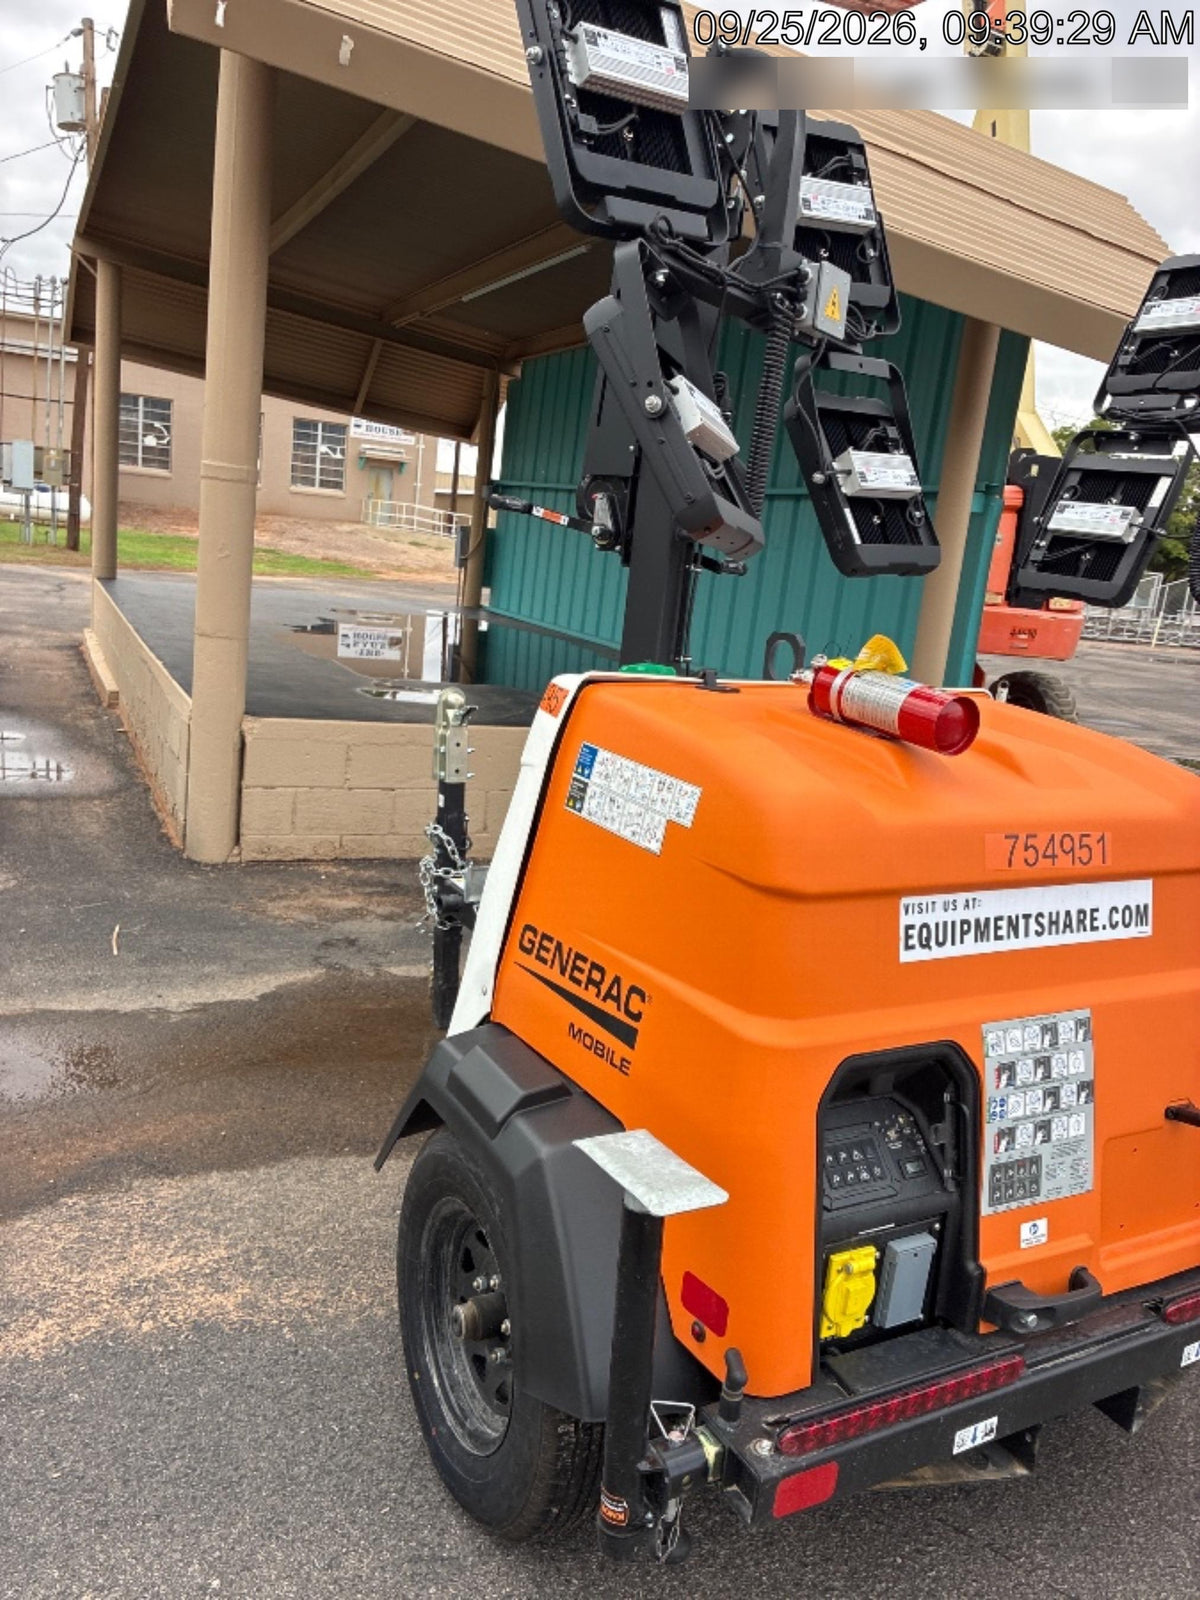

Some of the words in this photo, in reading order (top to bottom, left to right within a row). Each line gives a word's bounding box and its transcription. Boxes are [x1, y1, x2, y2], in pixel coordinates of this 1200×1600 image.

[1004, 833, 1107, 868] 754951
[903, 900, 937, 916] VISIT
[943, 899, 958, 912] US
[963, 897, 982, 911] AT:
[903, 903, 1149, 952] EQUIPMENTSHARE.COM
[518, 923, 646, 1023] GENERAC
[568, 1022, 632, 1077] MOBILE
